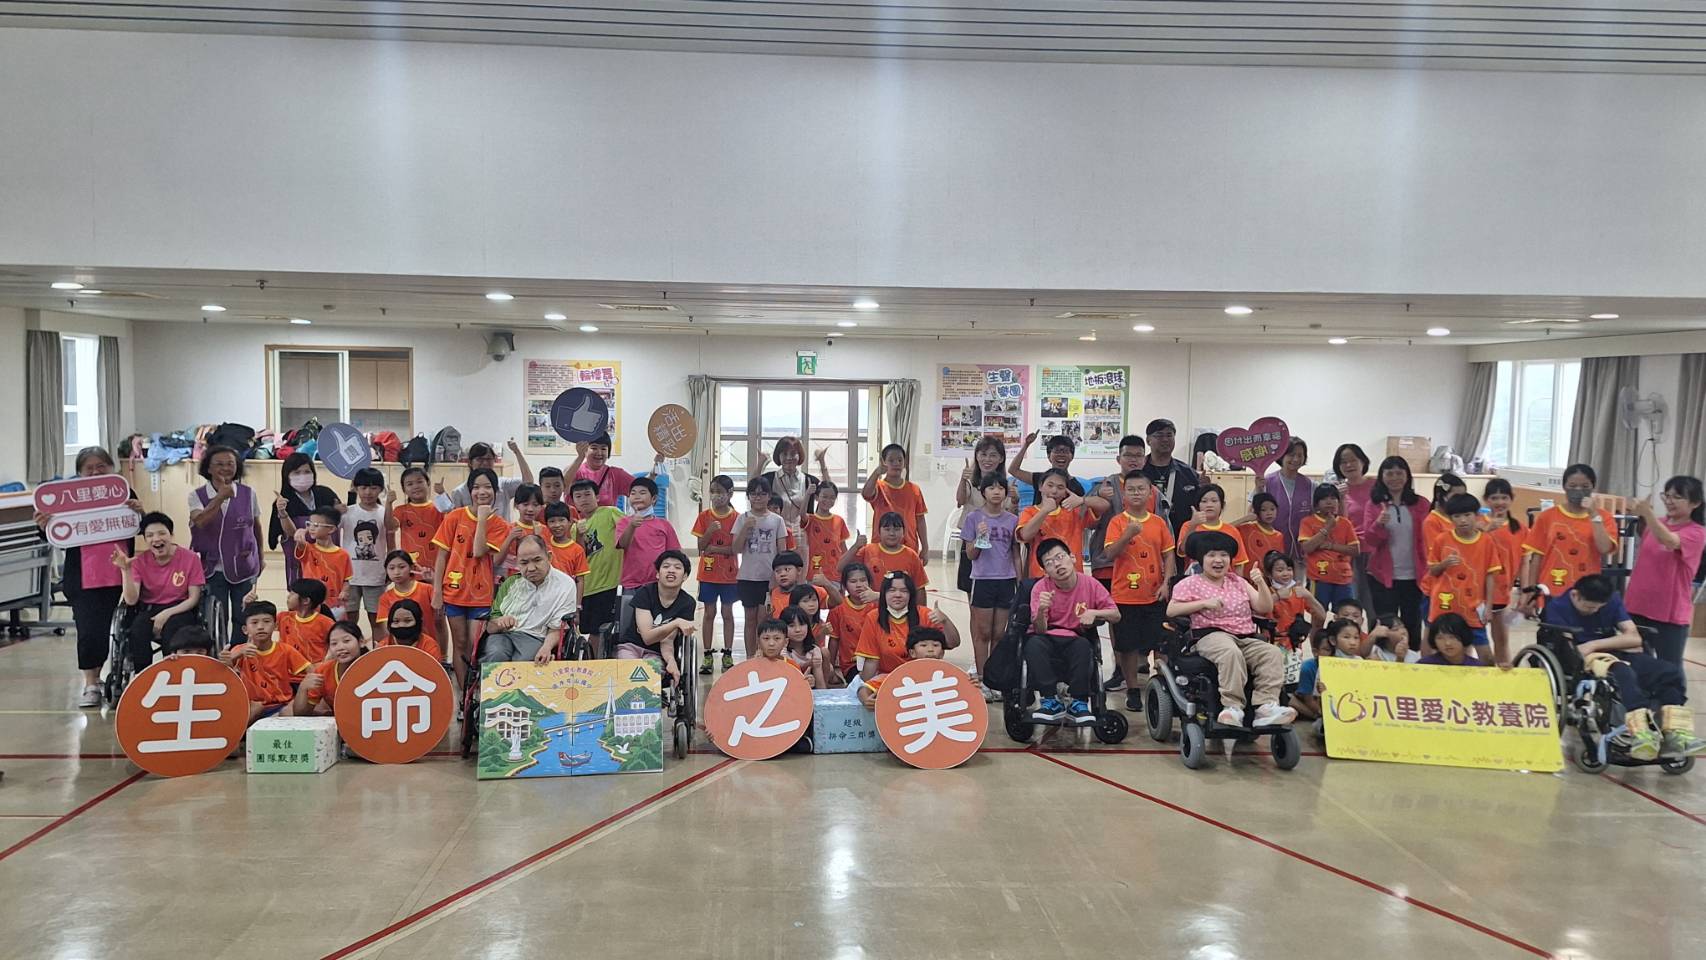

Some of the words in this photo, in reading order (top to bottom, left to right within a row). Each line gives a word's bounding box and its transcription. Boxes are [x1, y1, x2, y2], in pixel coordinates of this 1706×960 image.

[1240, 444, 1268, 462] 感謝
[60, 485, 124, 505] 八里愛心
[73, 514, 137, 536] 有愛無礙
[137, 667, 228, 754] 生
[354, 660, 437, 744] 命
[723, 670, 801, 747] 之
[892, 670, 978, 754] 美
[1371, 694, 1551, 729] 八里愛心教養院
[843, 718, 862, 728] 超級
[272, 739, 293, 749] 最佳
[256, 753, 309, 763] 團隊默契獎
